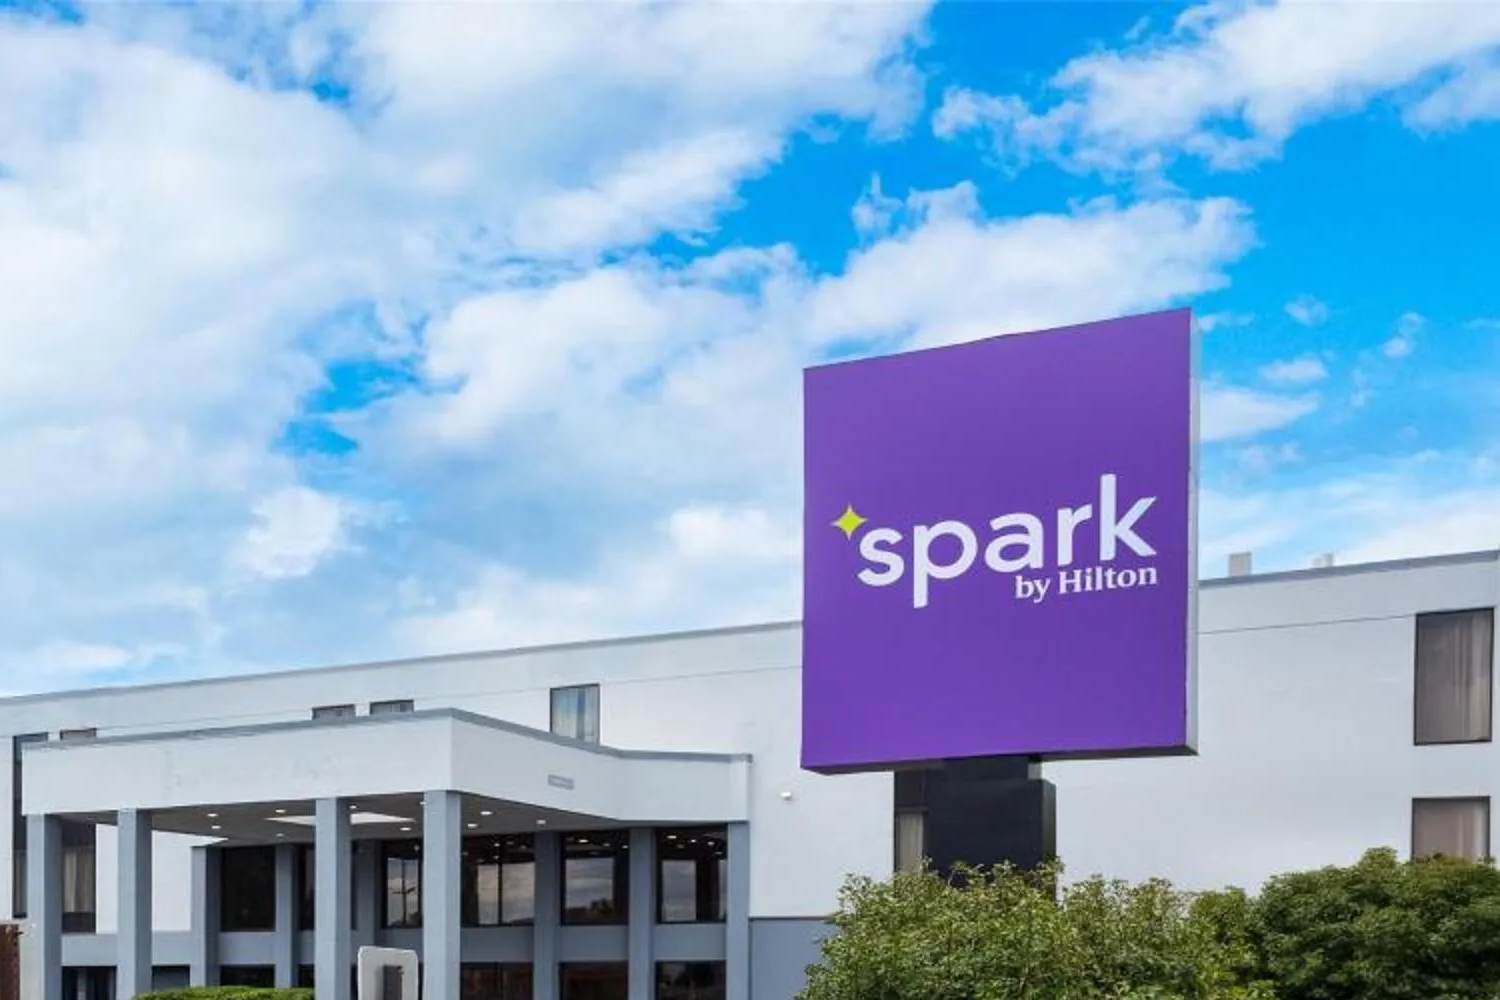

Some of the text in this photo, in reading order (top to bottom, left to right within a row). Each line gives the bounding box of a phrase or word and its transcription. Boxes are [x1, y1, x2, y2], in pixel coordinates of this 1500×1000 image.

[857, 473, 1157, 608] spark
[1015, 566, 1157, 603] by Hilton
